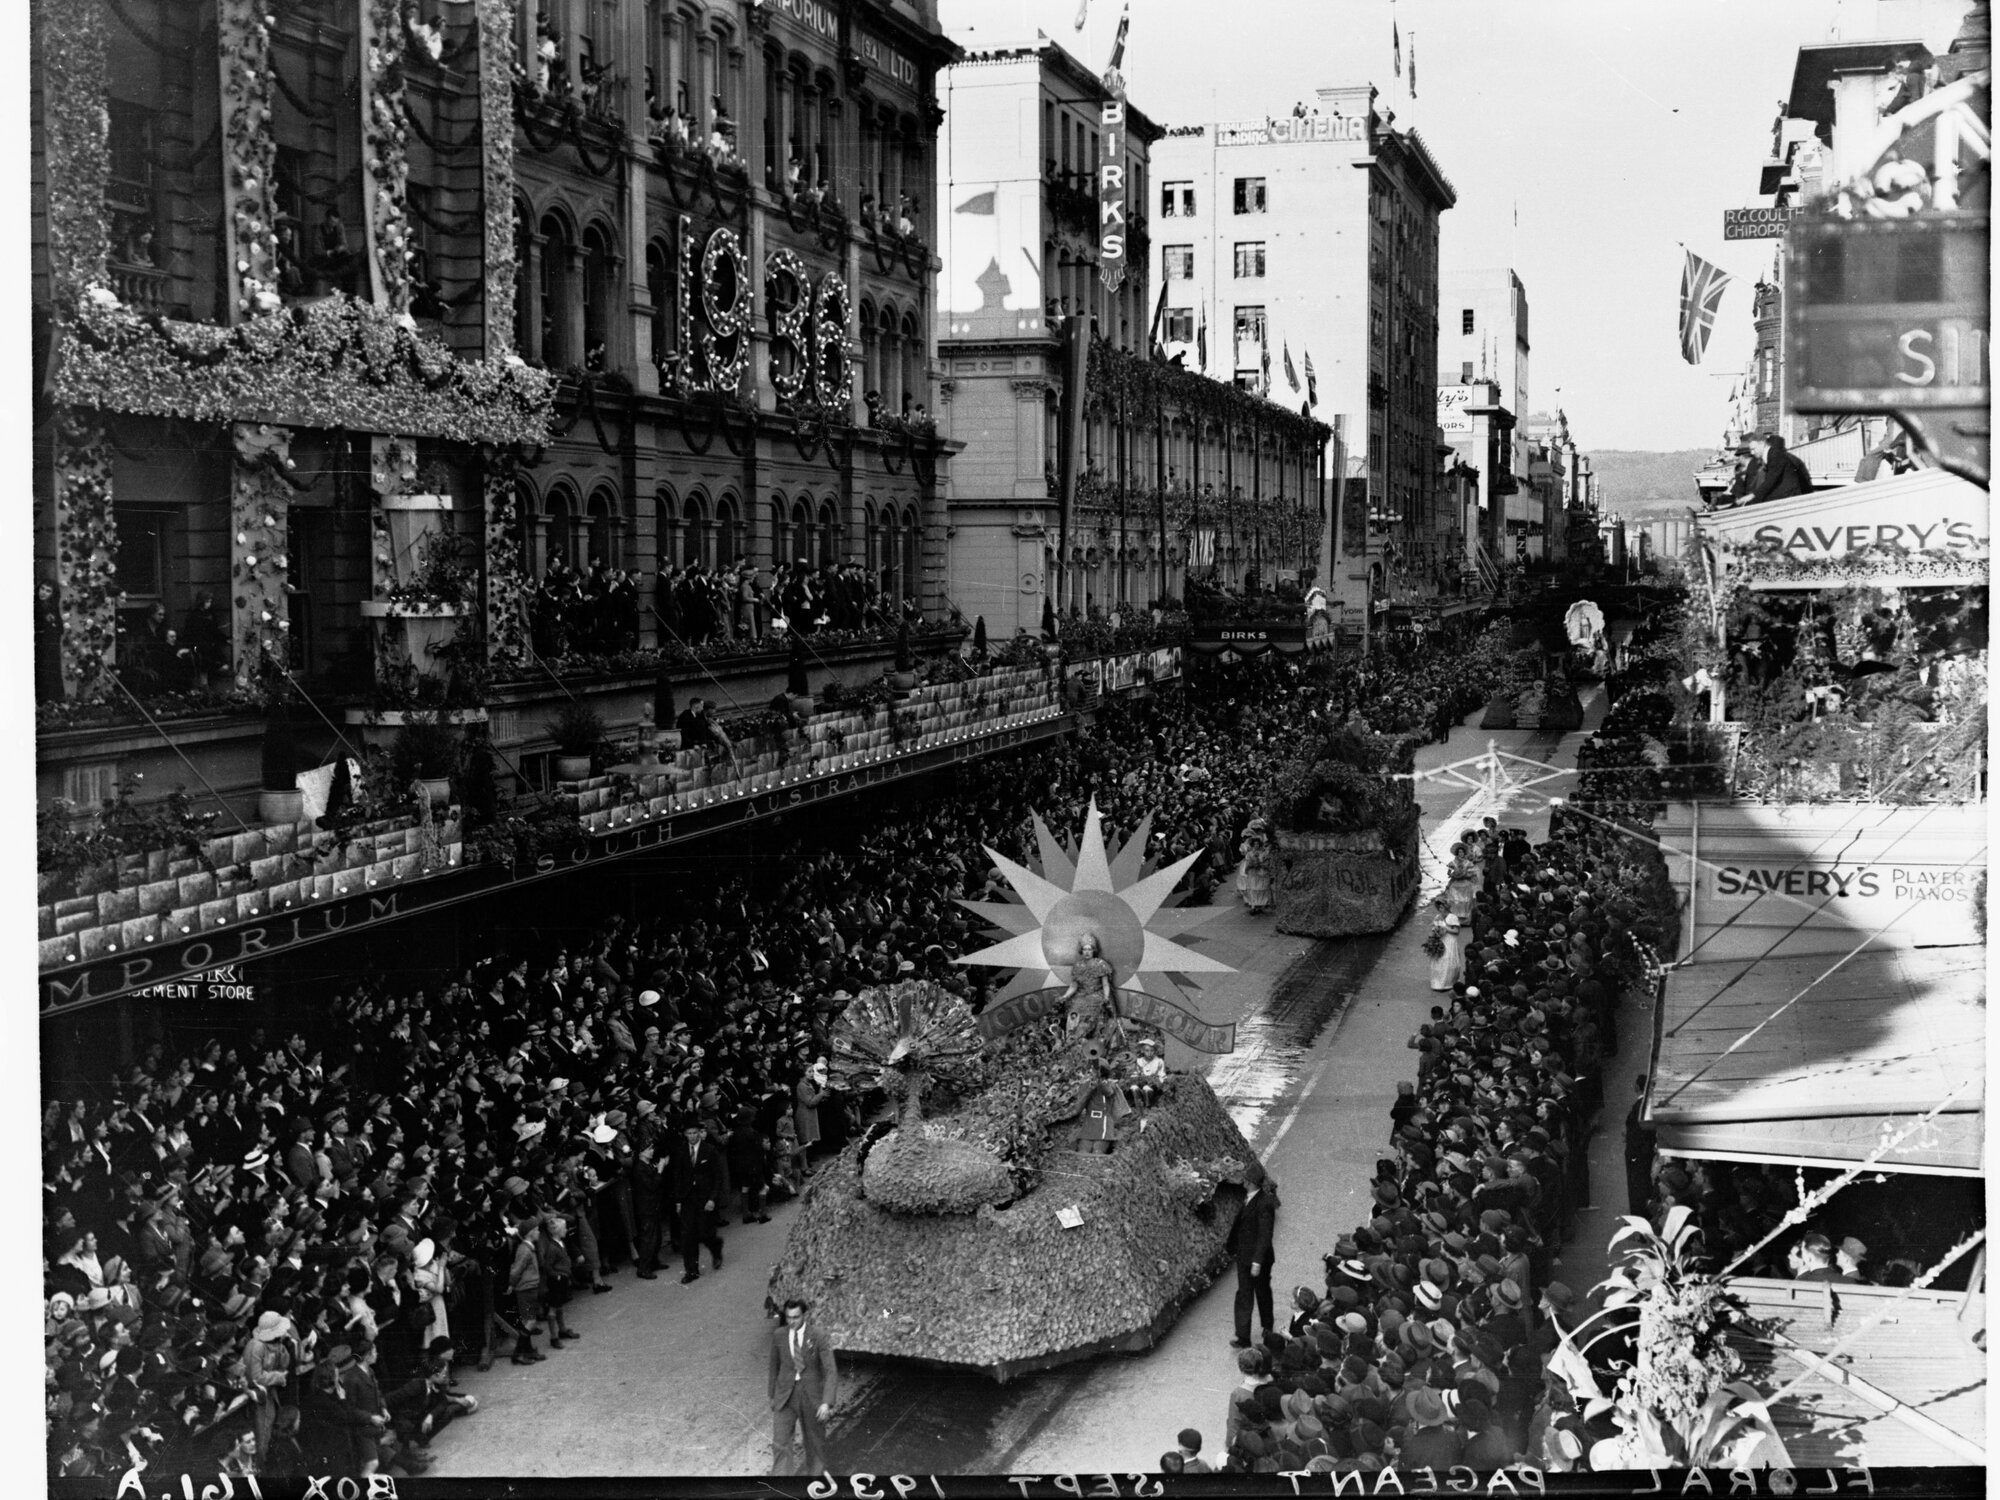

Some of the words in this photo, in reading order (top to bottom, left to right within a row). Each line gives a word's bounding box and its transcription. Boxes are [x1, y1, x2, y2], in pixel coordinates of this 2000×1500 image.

[891, 50, 913, 85] LTD
[1271, 118, 1366, 143] CINEMA
[1102, 101, 1124, 259] BIRKS
[676, 214, 855, 410] 1936
[1754, 517, 1974, 552] SAVERY'S
[1221, 631, 1267, 640] BIRKS
[1717, 866, 1880, 897] SAVERY'S
[1893, 868, 1965, 885] PLAYER
[1896, 885, 1969, 902] PIANOS
[208, 985, 255, 1000] STORE
